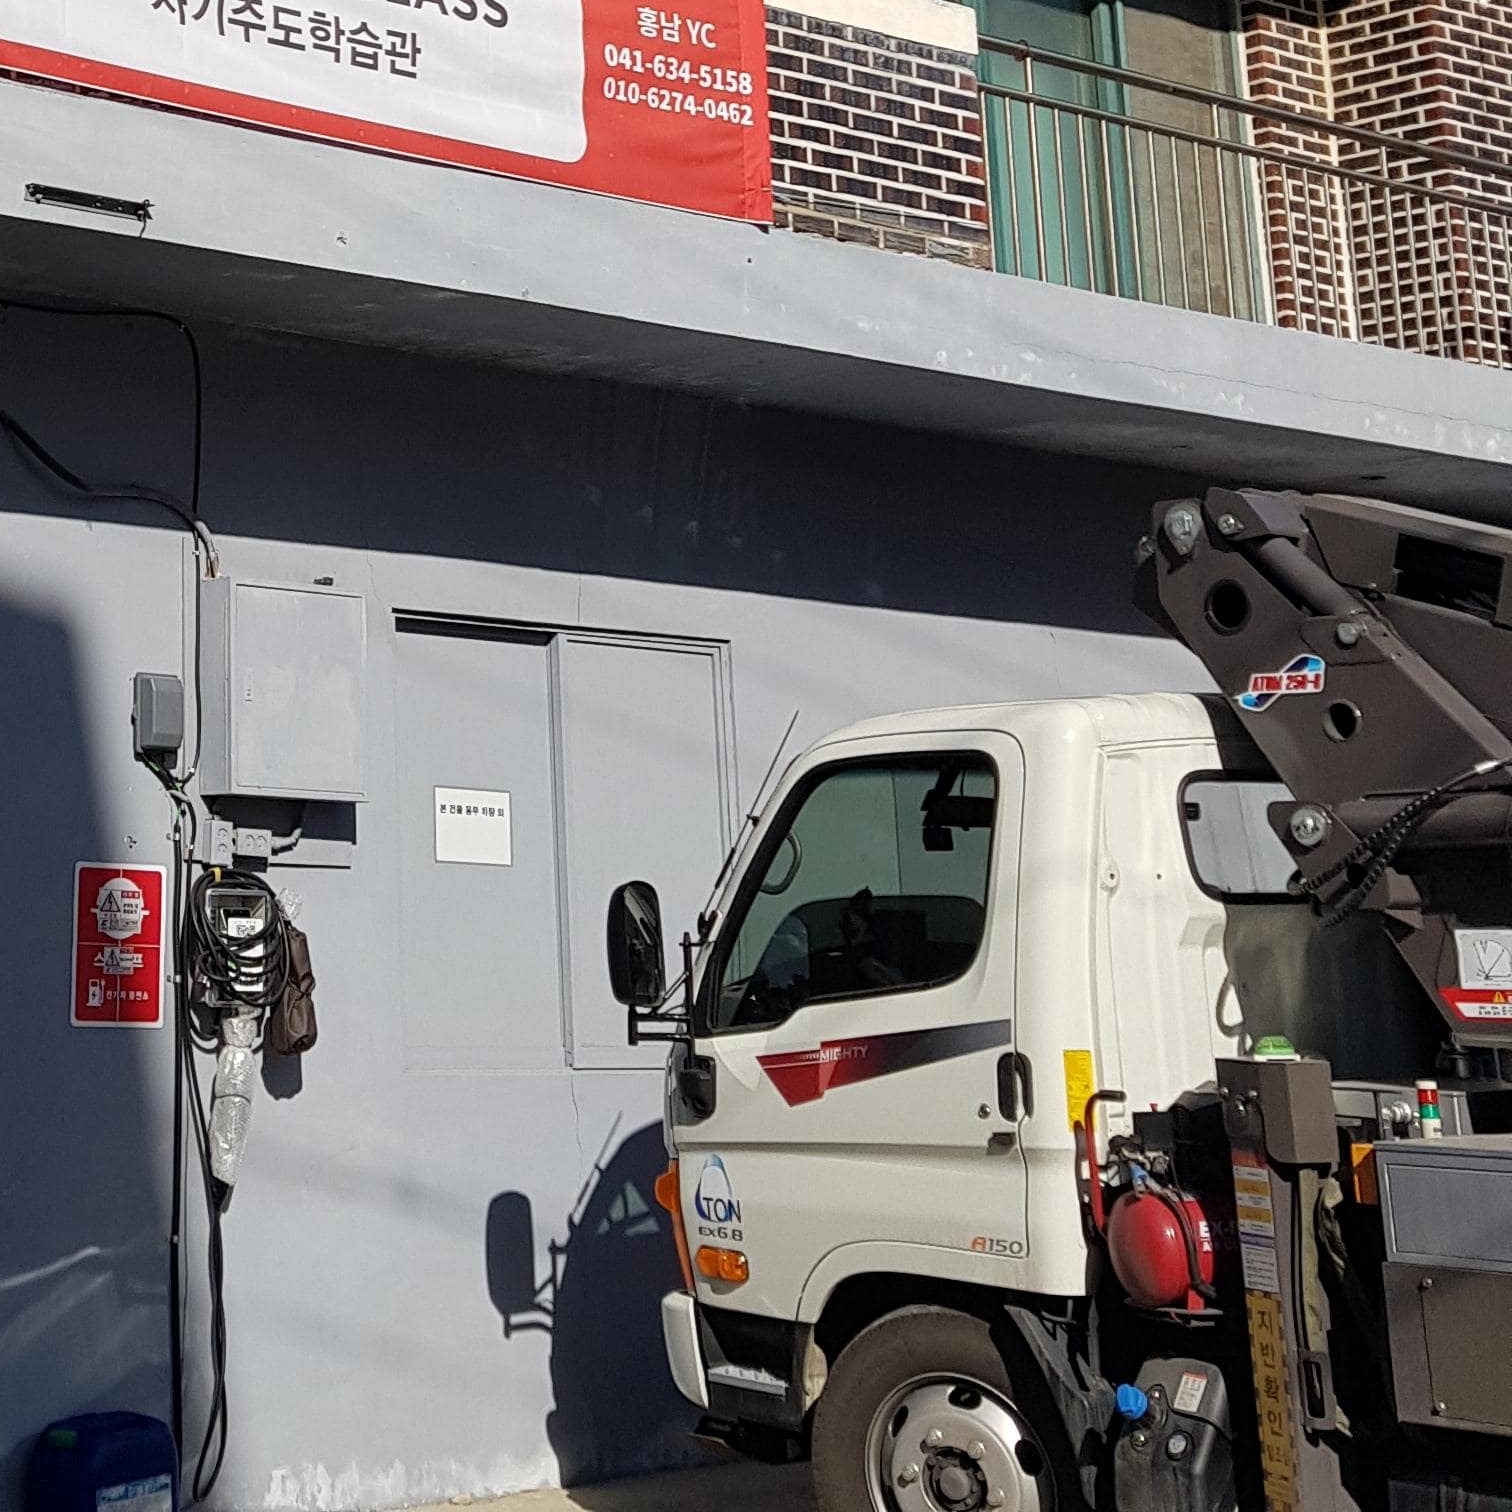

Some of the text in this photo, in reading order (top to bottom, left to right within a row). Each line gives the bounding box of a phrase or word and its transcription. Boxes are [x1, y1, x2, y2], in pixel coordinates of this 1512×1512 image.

[637, 5, 717, 50] 홍남 YC
[604, 41, 752, 96] 041-634-5158
[602, 77, 754, 127] 010-6274-0462
[819, 1044, 869, 1062] MIGHTY
[971, 1236, 1024, 1255] A150
